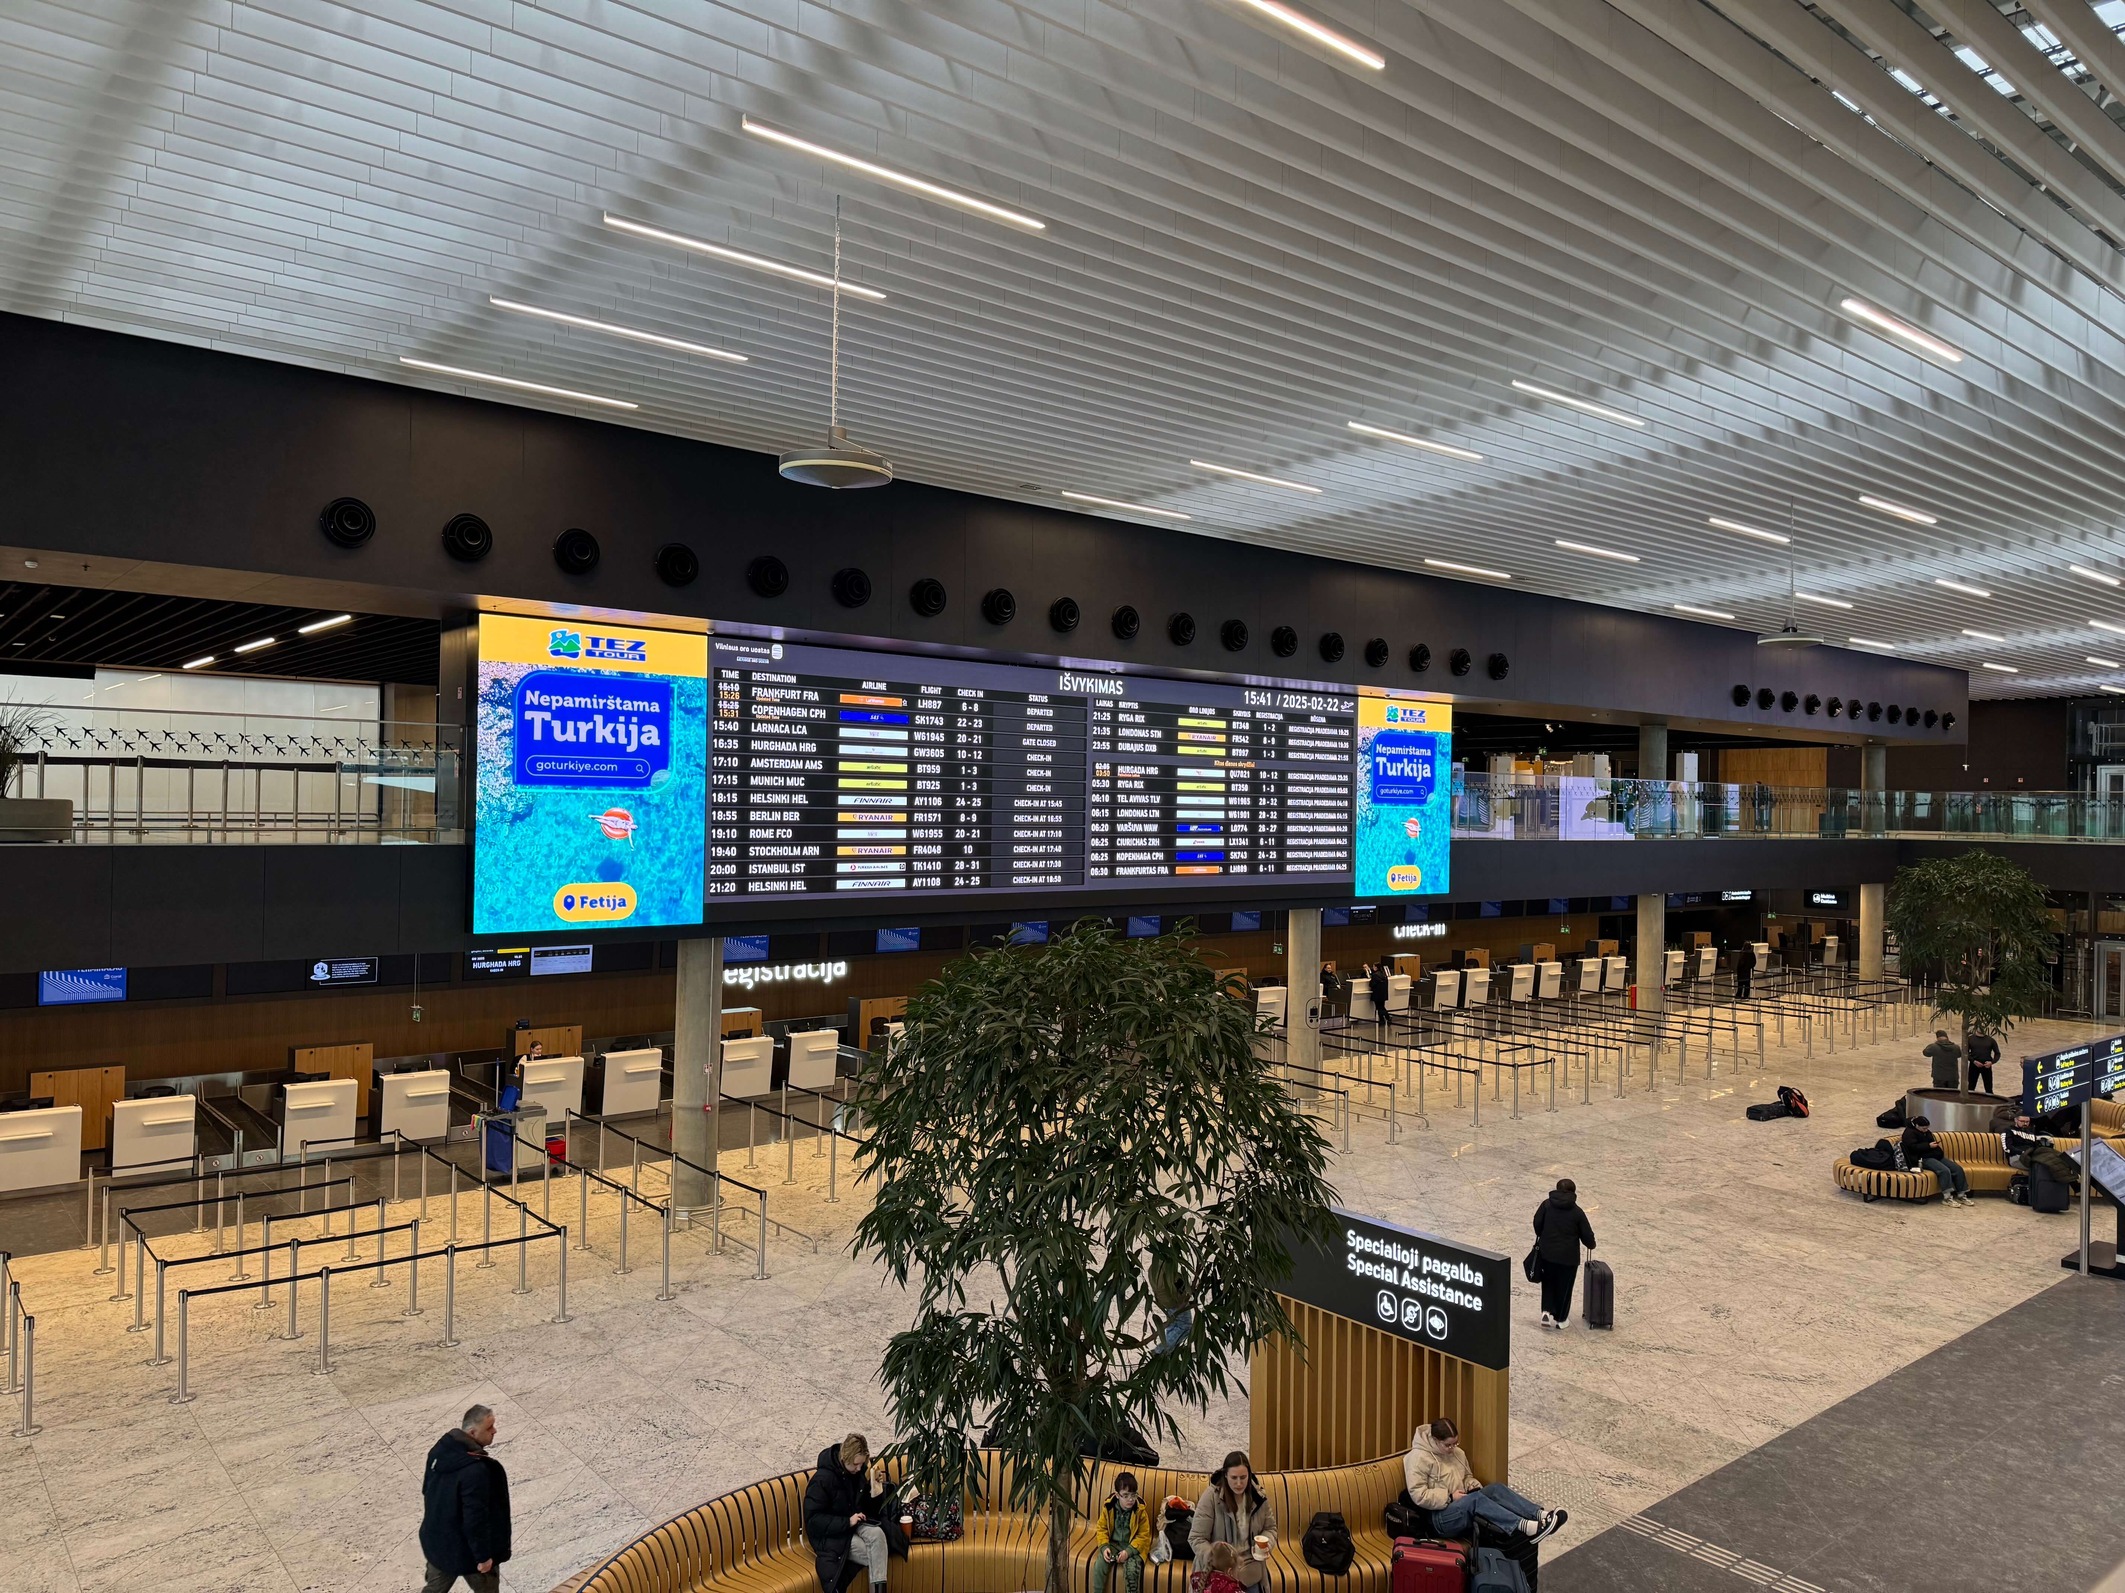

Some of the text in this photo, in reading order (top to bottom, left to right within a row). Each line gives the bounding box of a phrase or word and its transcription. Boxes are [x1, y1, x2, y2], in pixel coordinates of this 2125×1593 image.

[586, 636, 646, 650] TEZ
[595, 650, 640, 660] TOUR
[722, 670, 739, 679] TIME
[752, 672, 796, 683] DESTINATION
[862, 682, 886, 690] AIRLINE
[1060, 672, 1123, 694] IŠVYKIMAS
[752, 688, 801, 699] FRANKFURT
[803, 691, 819, 701] FRA
[921, 686, 941, 694] FLIGHT
[958, 689, 983, 698] CHECK IN
[720, 691, 740, 699] 15:26
[525, 690, 660, 712] Nepamirštama
[918, 699, 942, 709] LH887
[1245, 691, 1271, 705] 15:41
[1283, 695, 1338, 711] 2025-02-22
[720, 709, 738, 717] 15:31
[752, 706, 807, 717] COPENHAGEN
[810, 709, 826, 719] CPH
[1027, 708, 1053, 716] DEPARTED
[1093, 712, 1110, 721] 21:25
[1401, 709, 1425, 717] TEZ
[915, 716, 943, 726] SK1743
[1119, 714, 1133, 722] RYGA
[714, 721, 738, 731] 15:40
[752, 722, 807, 735] LARNACA LCA
[525, 711, 660, 752] Turkija
[1093, 727, 1110, 735] 21:35
[914, 732, 944, 742] W61945
[713, 739, 738, 749] 16:35
[751, 740, 816, 752] HURGHADA HRG
[1022, 738, 1056, 747] GATE CLOSED
[1093, 742, 1110, 750] 23:55
[914, 747, 944, 758] GW3605
[1376, 744, 1431, 756] Nepamirštama
[713, 757, 738, 767] 17:10
[1027, 754, 1051, 762] CHECK-IN
[536, 761, 618, 772] goturkiye.com
[751, 758, 823, 769] AMSTERDAM AMS
[917, 764, 940, 774] BT959
[1027, 769, 1051, 777] CHECK-IN
[1376, 757, 1431, 782] Turkija
[713, 775, 738, 785] 17:15
[751, 776, 805, 786] MUNICH MUC
[1092, 779, 1109, 787] 05:30
[917, 781, 940, 790] BT925
[1380, 788, 1414, 796] goturkiye.com
[712, 793, 738, 802] 18:15
[750, 794, 808, 804] HELSINKI HEL
[914, 797, 942, 806] AY1106
[1092, 794, 1109, 802] 06:10
[1118, 795, 1128, 803] TEL
[712, 811, 737, 820] 18:55
[750, 811, 800, 821] BERLIN BER
[914, 813, 941, 822] FR1571
[1092, 809, 1109, 817] 06:15
[712, 829, 737, 838] 19:10
[750, 829, 792, 838] ROME FCO
[912, 829, 943, 838] W61955
[711, 847, 736, 856] 19:40
[749, 846, 819, 856] STOCKHOLM ARN
[913, 846, 941, 854] FR4048
[710, 865, 736, 874] 20:00
[749, 864, 805, 874] ISTANBUL IST
[913, 861, 941, 870] TK1410
[1090, 868, 1108, 876] 06:30
[913, 878, 941, 887] AY1108
[1397, 874, 1417, 883] Fetija
[710, 883, 735, 893] 21:20
[748, 881, 806, 891] HELSINKI HEL
[580, 895, 627, 911] Fetija
[473, 960, 507, 969] HURGHADA
[1347, 1229, 1483, 1287] Specialioji pagalba
[1347, 1254, 1482, 1311] Special Assistance
